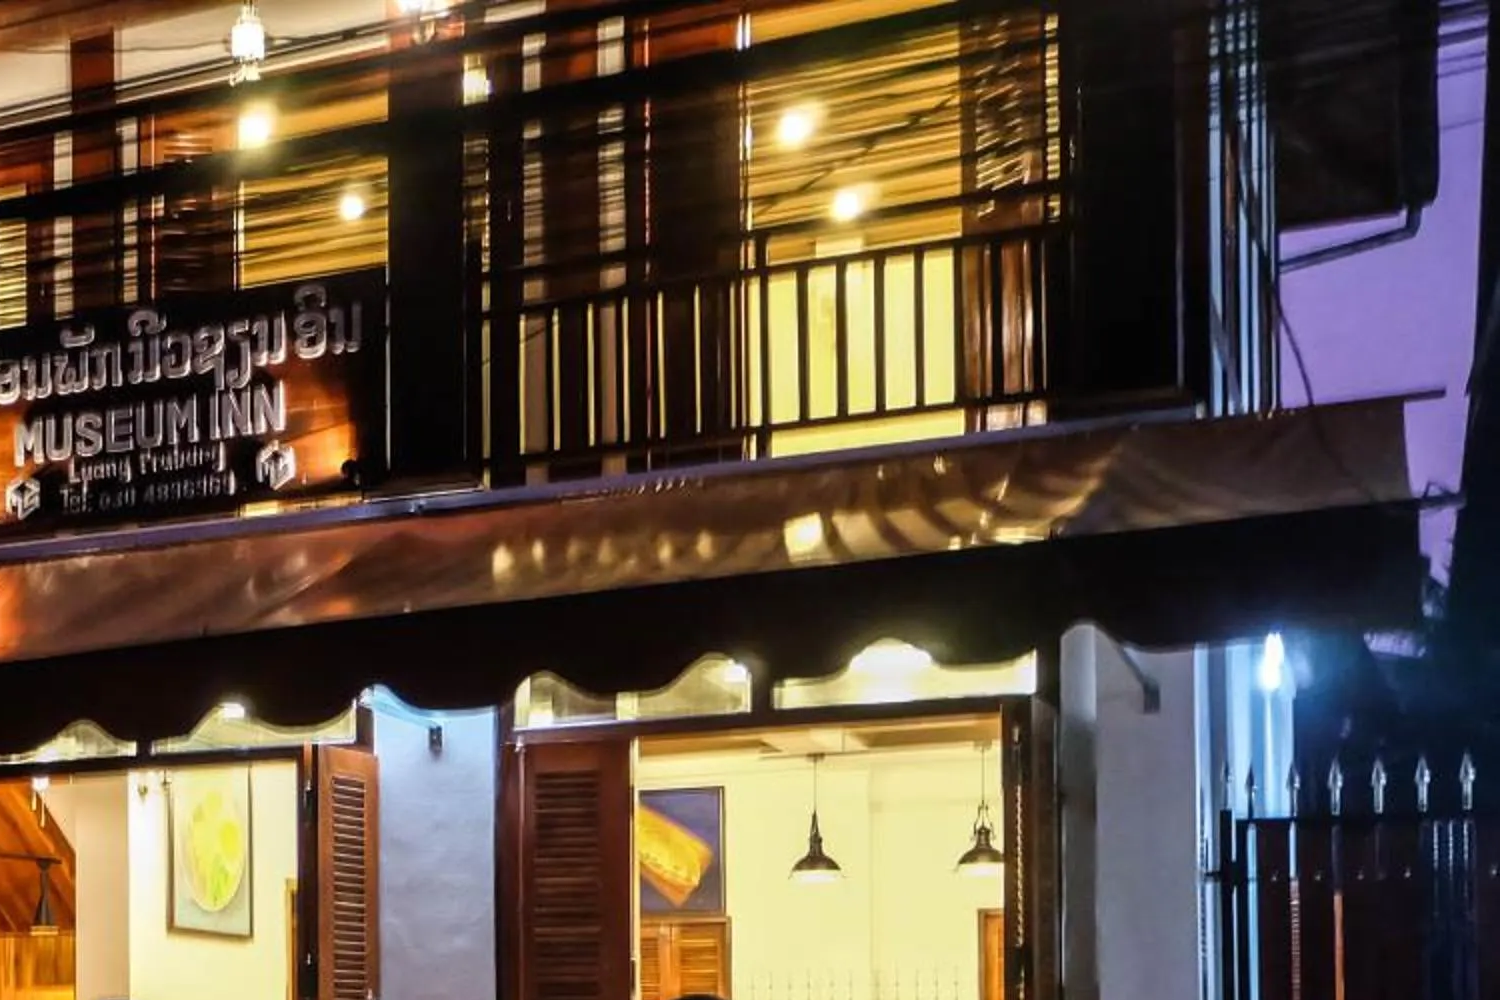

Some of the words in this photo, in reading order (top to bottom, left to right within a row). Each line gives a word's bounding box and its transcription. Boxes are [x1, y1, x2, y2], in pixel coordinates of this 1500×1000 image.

[13, 392, 200, 467] MUSEUM
[209, 380, 287, 441] INN
[68, 454, 132, 483] Luang
